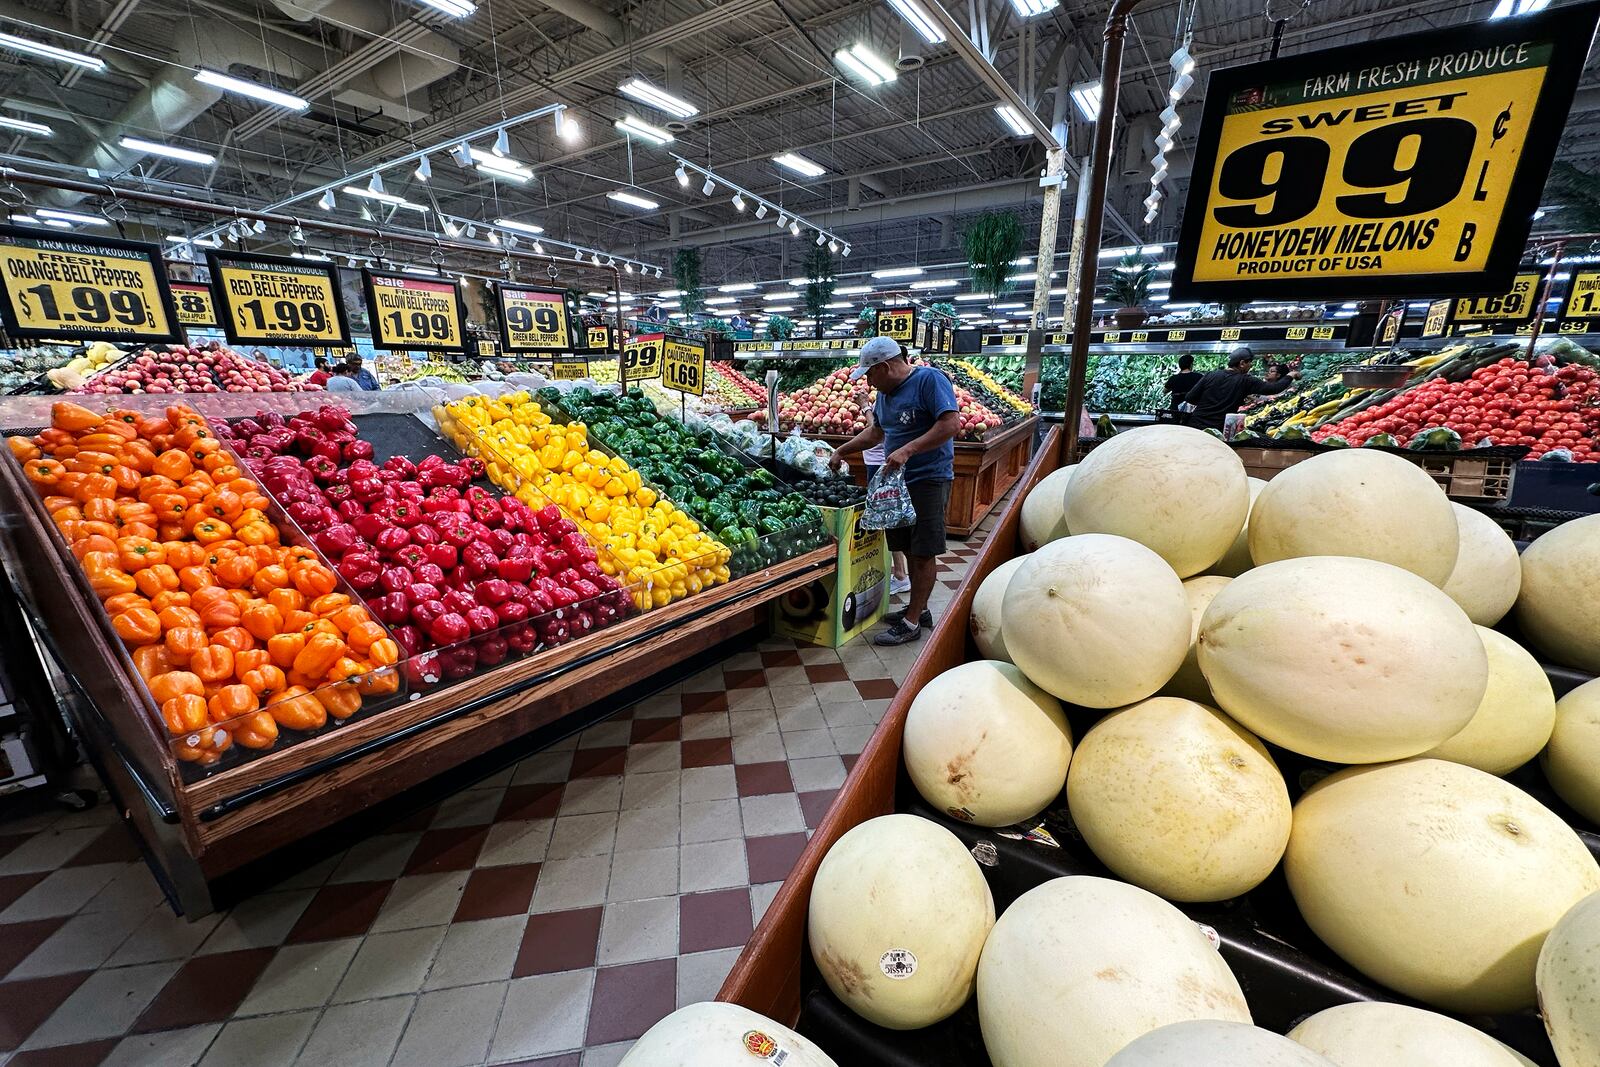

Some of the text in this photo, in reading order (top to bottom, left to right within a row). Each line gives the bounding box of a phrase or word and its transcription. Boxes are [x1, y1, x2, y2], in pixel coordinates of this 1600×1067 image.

[1302, 41, 1532, 98] FARM FRESH PRODUCE
[1260, 92, 1468, 135] SWEET
[1213, 117, 1478, 229] 99
[37, 239, 142, 259] FARM FRESH PRODUCE
[1211, 218, 1440, 261] HONEYDEW MELONS
[37, 252, 106, 267] FRESH
[250, 261, 324, 276] FARM FRESH PRODUCE
[1236, 255, 1383, 275] PRODUCT OF USA
[7, 258, 144, 289] ORANGE BELL PEPPERS
[251, 273, 299, 284] FRESH
[375, 276, 405, 288] sale
[230, 278, 325, 301] RED BELL PEPPERS
[394, 288, 431, 298] FRESH
[505, 290, 527, 299] sale
[18, 283, 147, 326] $1.99
[379, 293, 450, 313] YELLOW BELL PEPPERS
[512, 300, 554, 308] FRESH
[1459, 293, 1522, 314] $1.69
[1571, 292, 1600, 312] $1.
[237, 299, 327, 333] $1.99
[383, 310, 450, 340] $1.99
[506, 306, 560, 334] 99
[879, 318, 908, 333] 88
[59, 323, 102, 332] PRODUCT
[265, 332, 290, 340] PRODUCT
[512, 332, 559, 342] GREEN BELL PEPPERS
[588, 331, 606, 343] 79
[627, 341, 656, 350] FRESH
[674, 345, 692, 353] FRESH
[623, 345, 657, 369] 99
[667, 348, 701, 366] CAULIFLOWER
